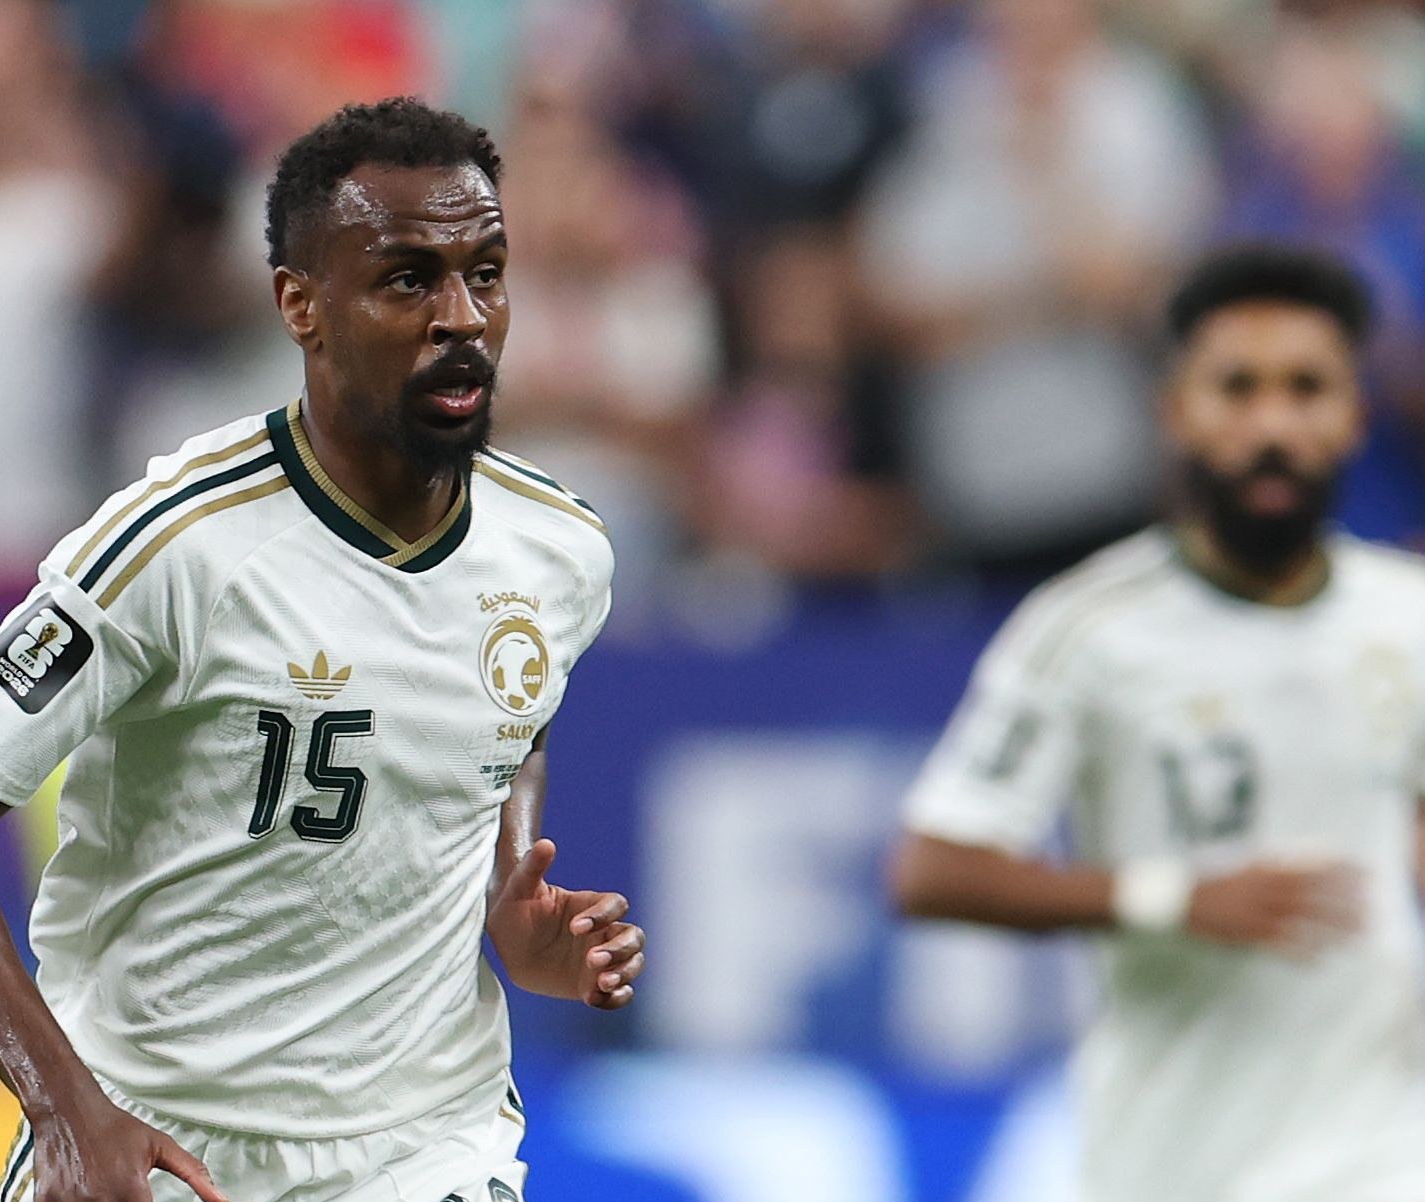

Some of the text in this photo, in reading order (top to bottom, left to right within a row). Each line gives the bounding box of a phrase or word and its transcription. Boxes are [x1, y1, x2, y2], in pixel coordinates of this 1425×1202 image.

[17, 653, 36, 670] FIFA
[522, 674, 543, 686] SAFF
[248, 709, 375, 844] 15
